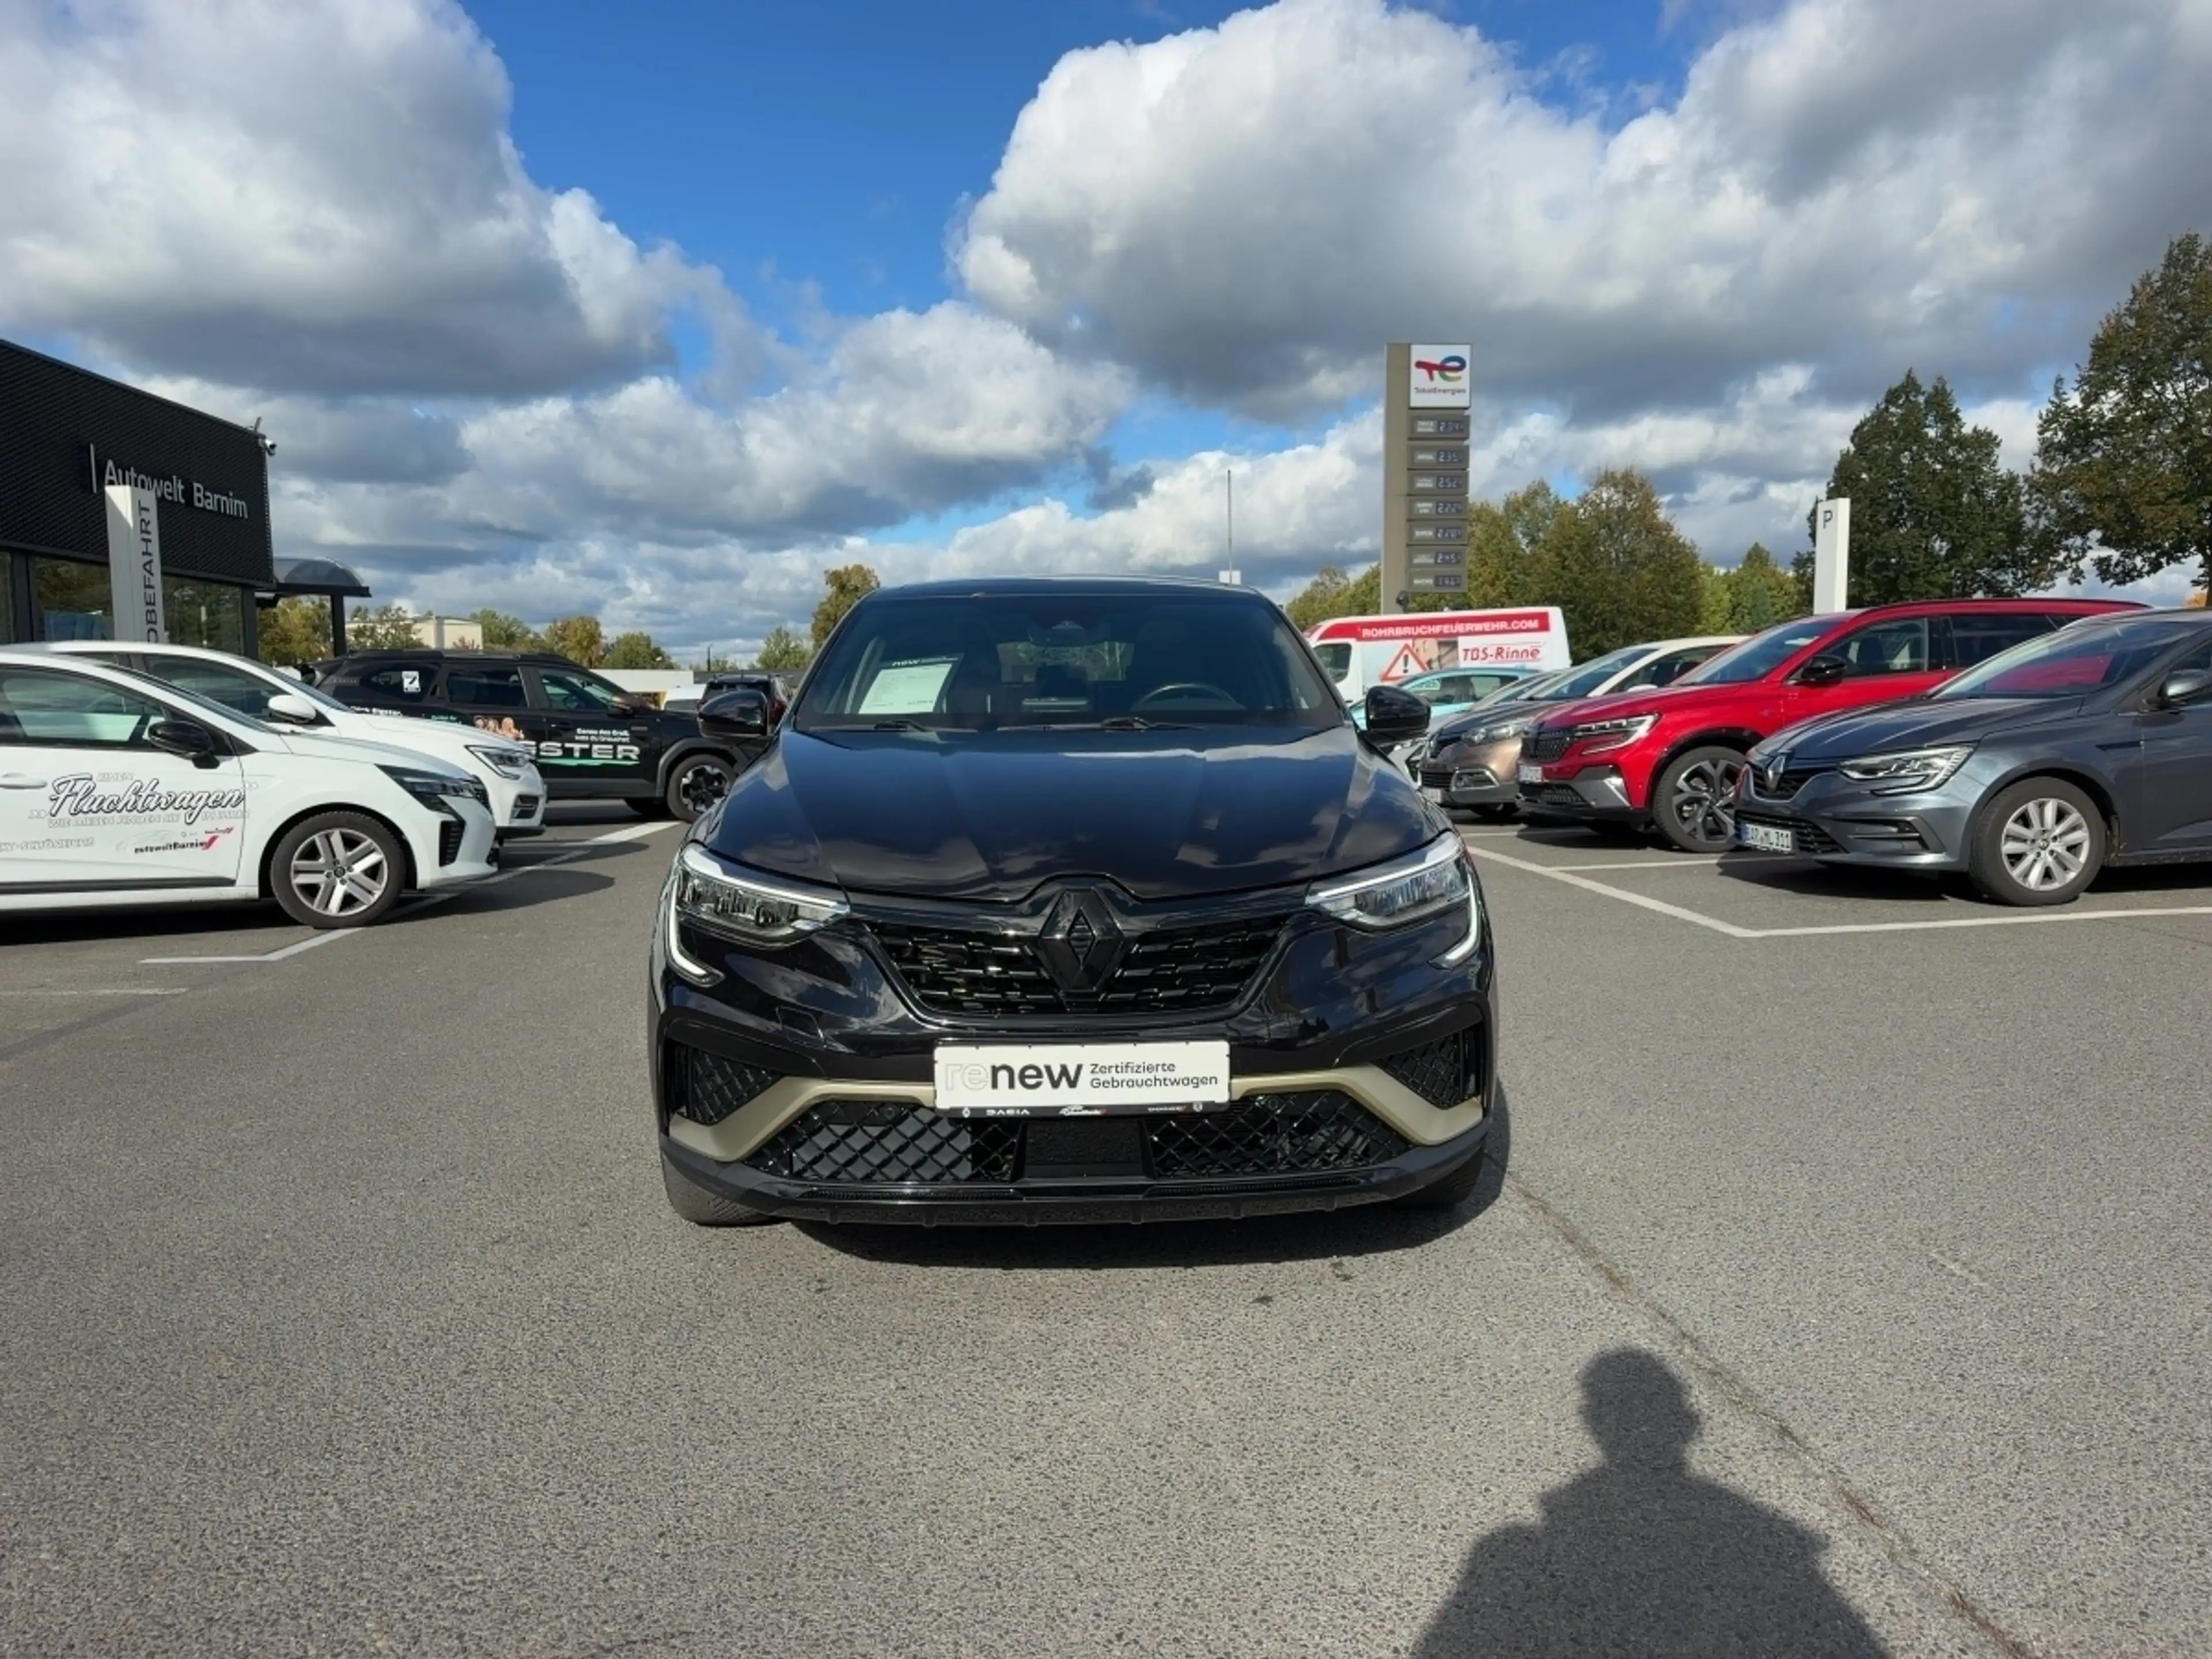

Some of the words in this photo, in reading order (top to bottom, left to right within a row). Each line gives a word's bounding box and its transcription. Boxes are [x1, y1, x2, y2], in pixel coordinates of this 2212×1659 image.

[1414, 387, 1467, 396] TotalEnergies
[104, 459, 185, 504] Autowelt
[192, 482, 248, 519] Barnim
[1823, 510, 1833, 529] P
[1362, 619, 1539, 638] ROHRBRUCHFEUERWEHR.COM
[1463, 645, 1541, 661] TBS-Rinne
[50, 773, 245, 825] Fluchtwagen
[945, 1063, 1082, 1090] renew
[1090, 1062, 1175, 1074] Zertifizierte
[1090, 1075, 1218, 1089] Gebrauchtwagen
